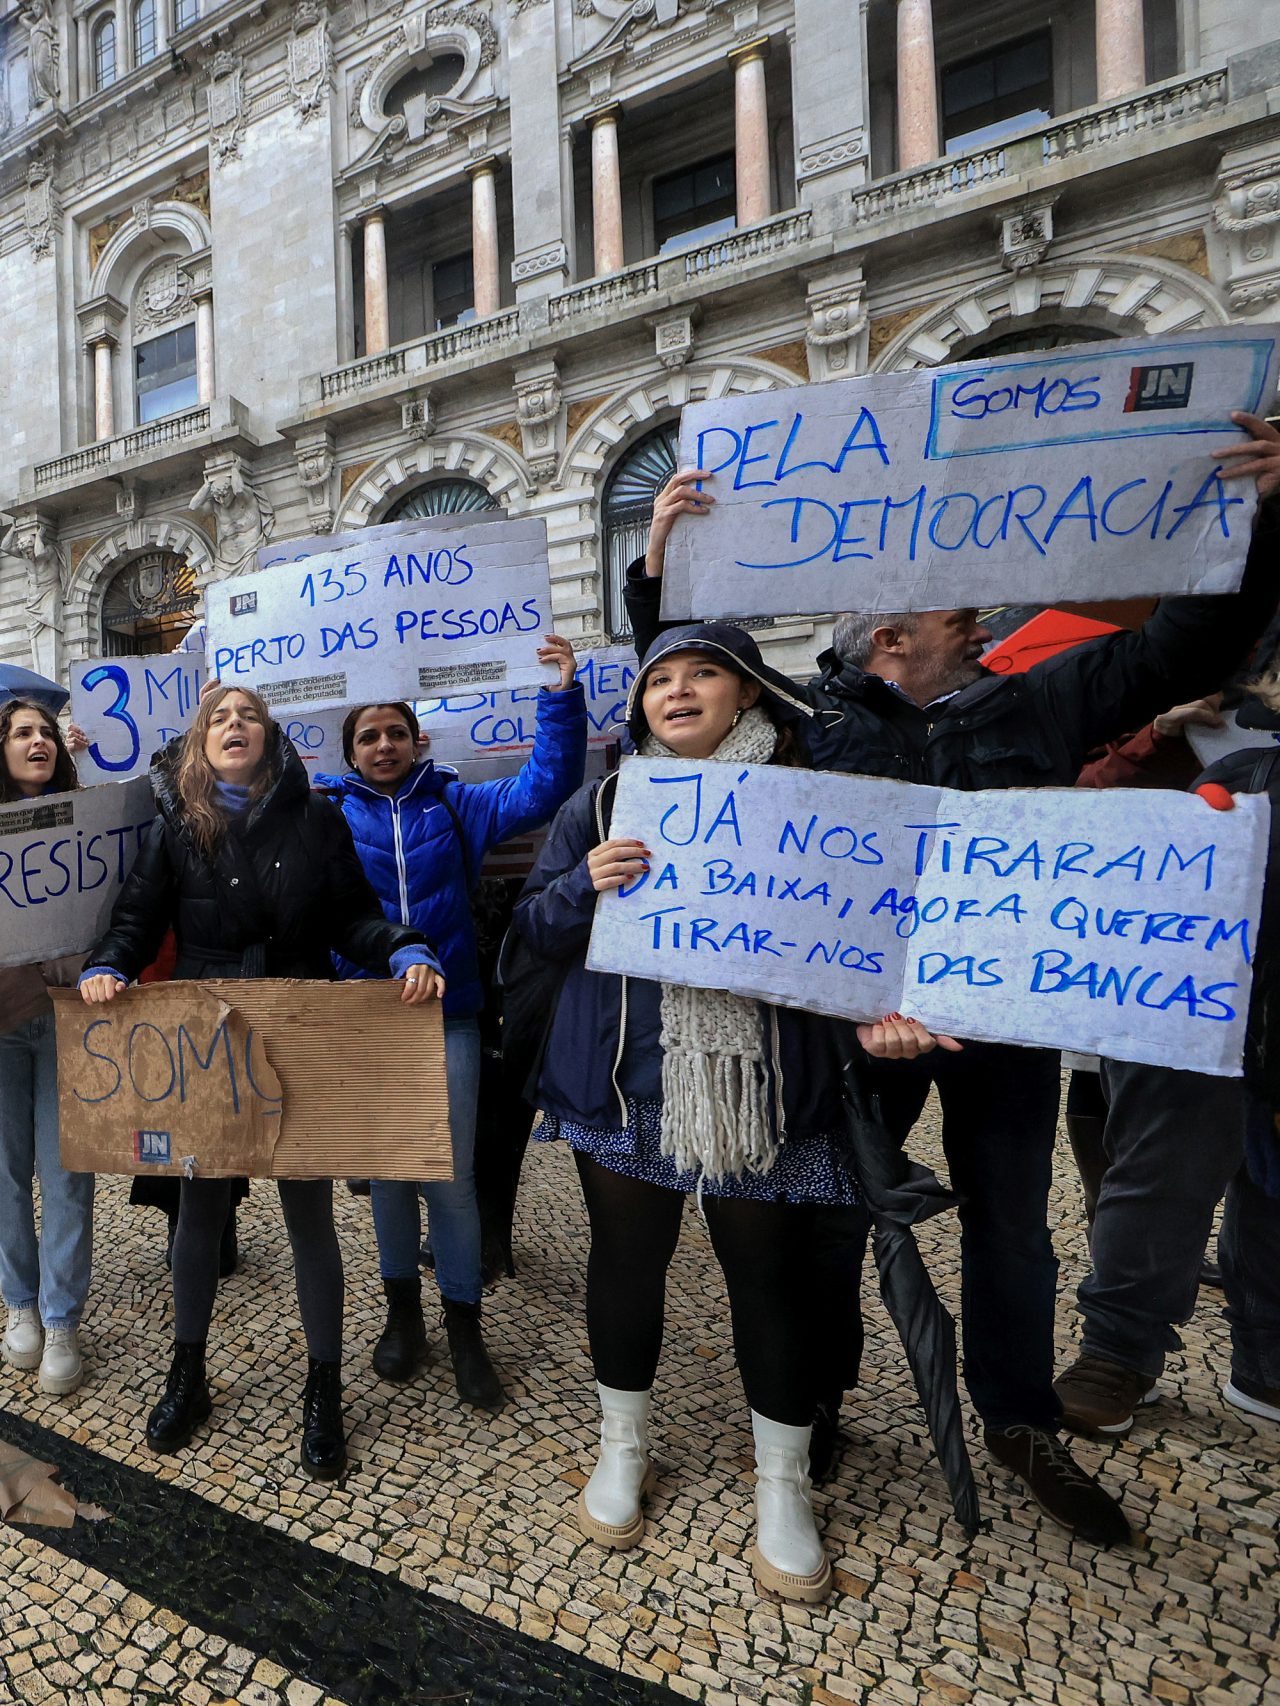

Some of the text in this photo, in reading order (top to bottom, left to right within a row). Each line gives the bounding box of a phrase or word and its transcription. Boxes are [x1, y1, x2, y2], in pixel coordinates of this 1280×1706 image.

[1140, 366, 1189, 399] JN
[696, 406, 890, 505] PELA
[735, 466, 1244, 568] DEMOCRACIA
[234, 592, 257, 612] JN
[299, 544, 474, 608] 135 ANOS
[214, 633, 306, 680] PERTO
[318, 616, 379, 659] DAS
[395, 598, 542, 644] PESSOAS
[80, 664, 141, 772] 3
[647, 771, 752, 847] JÁ
[777, 813, 885, 865] NOS
[699, 858, 851, 919] BAIXA,
[1049, 896, 1252, 964] QUEREM
[917, 950, 1005, 987] DAS
[1029, 948, 1238, 1023] BANCAS
[142, 1133, 168, 1155] JN
